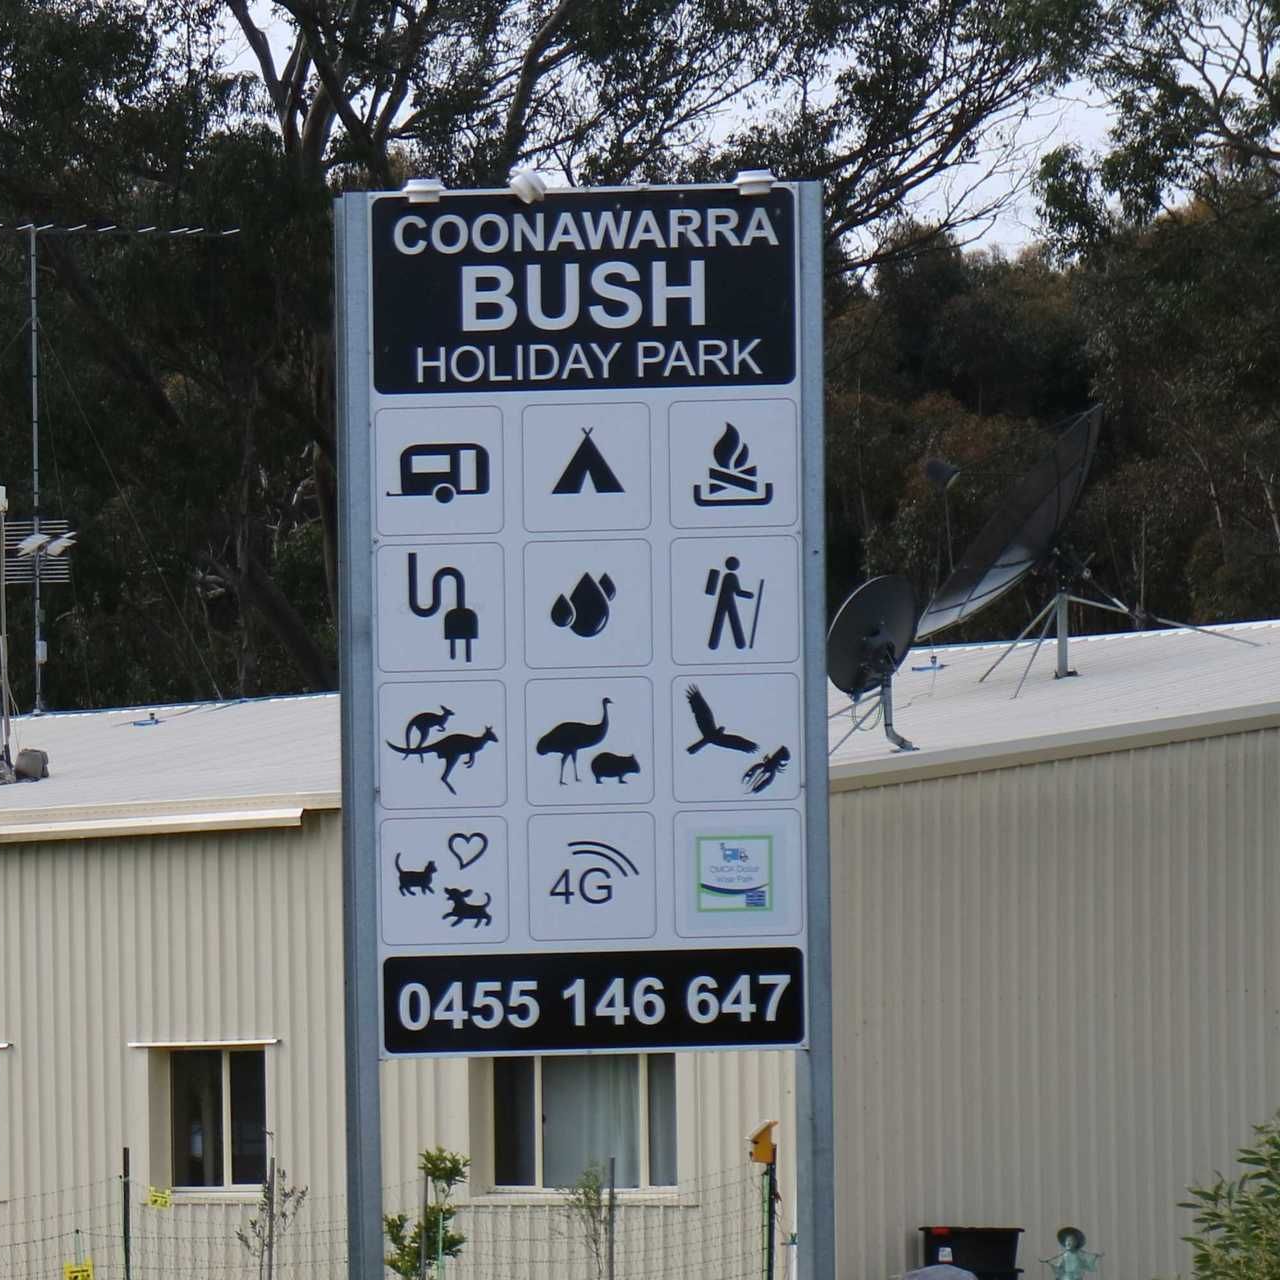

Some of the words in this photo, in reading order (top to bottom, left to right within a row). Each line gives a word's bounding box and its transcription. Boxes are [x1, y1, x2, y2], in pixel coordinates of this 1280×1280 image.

[394, 208, 780, 255] COONAWARRA
[462, 260, 706, 332] BUSH
[416, 343, 622, 383] HOLIDAY
[638, 339, 763, 378] PARK
[549, 867, 613, 905] 4G
[398, 980, 540, 1031] 0455
[562, 976, 666, 1027] 146
[686, 975, 791, 1024] 647
